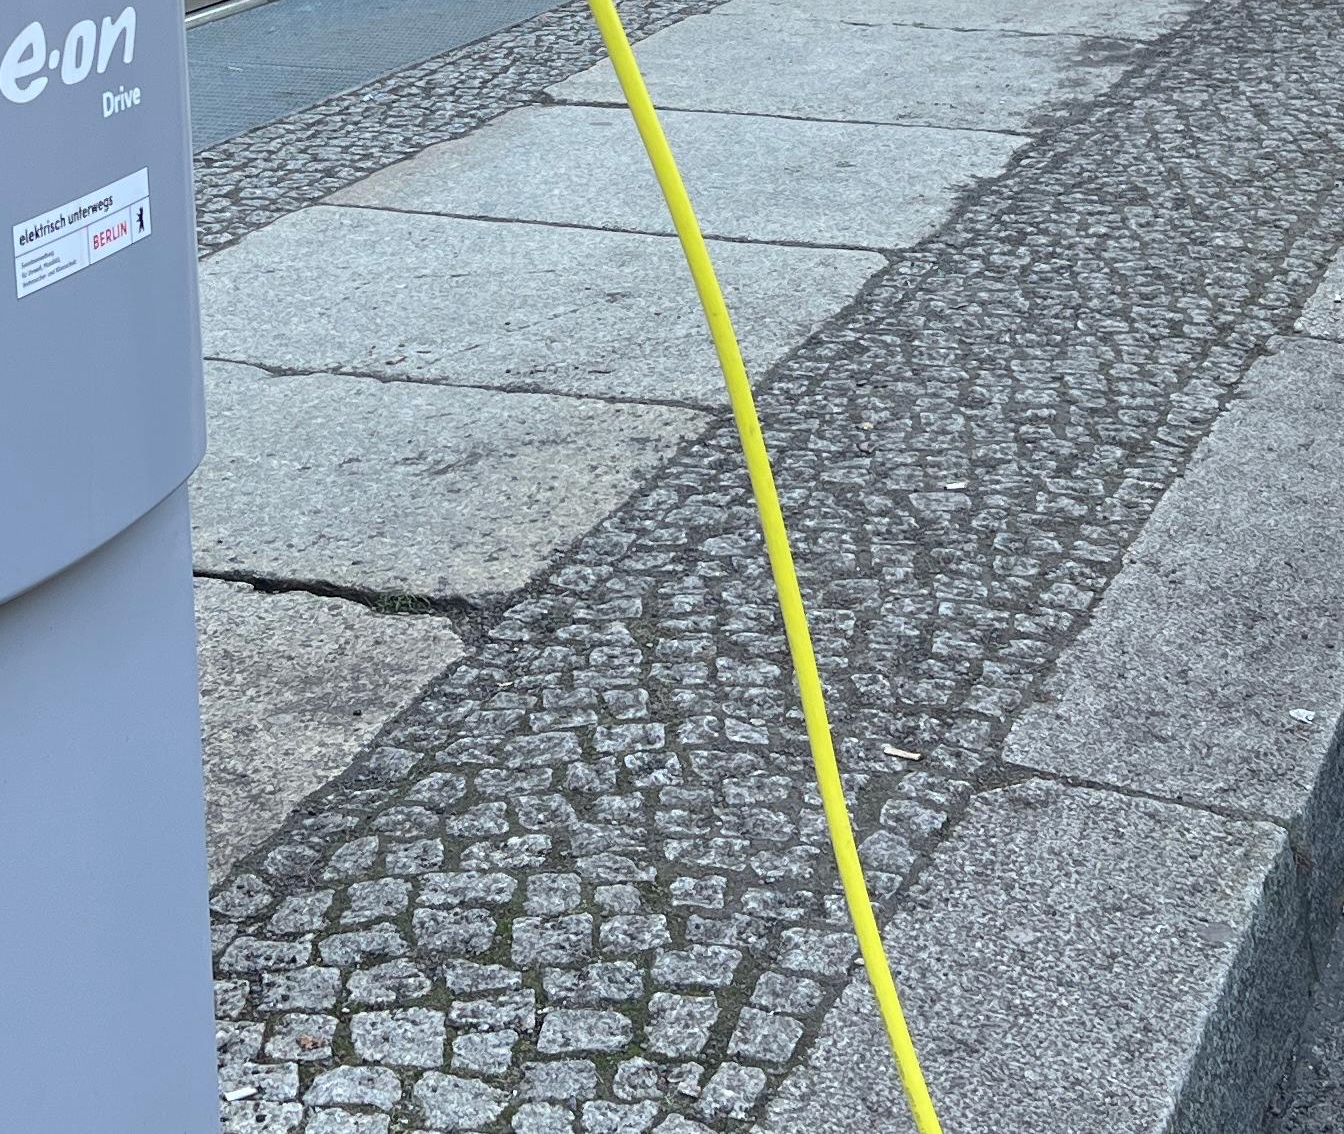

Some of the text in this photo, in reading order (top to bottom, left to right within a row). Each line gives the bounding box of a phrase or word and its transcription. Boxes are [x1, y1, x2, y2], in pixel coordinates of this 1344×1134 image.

[102, 86, 141, 118] Drive
[20, 196, 114, 246] elektrisch unterwegs
[92, 220, 128, 250] BERLIN
